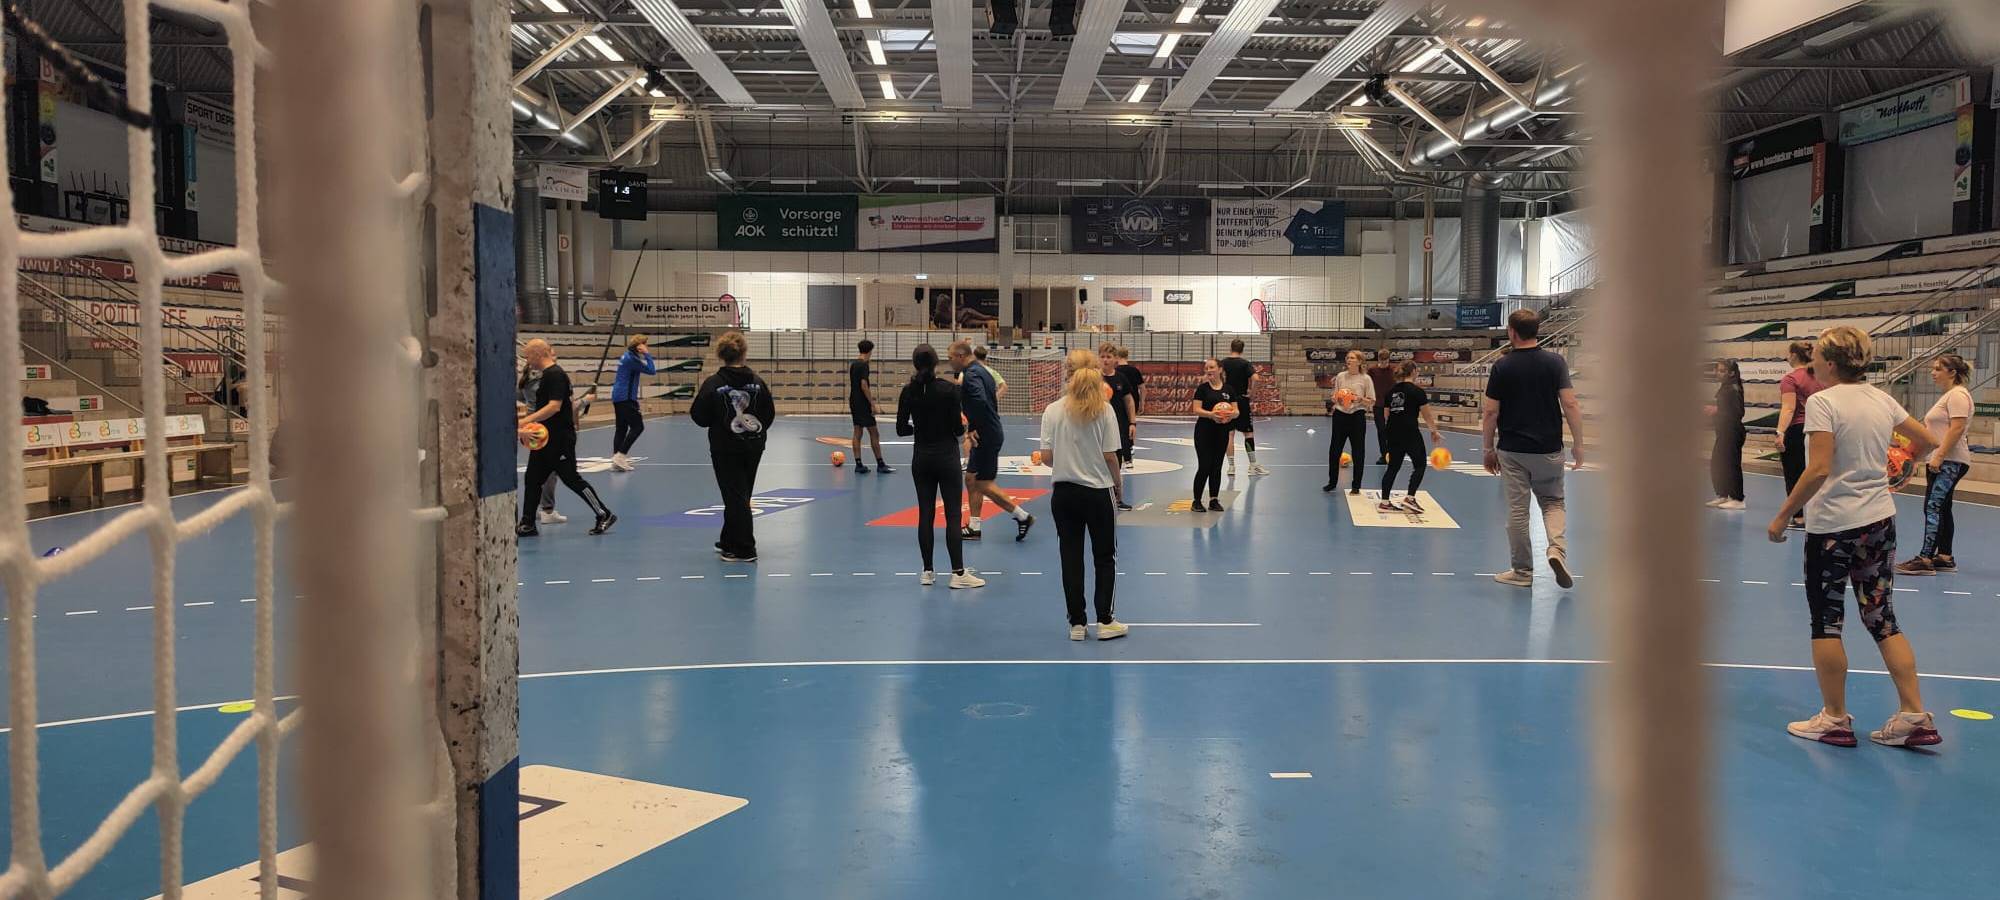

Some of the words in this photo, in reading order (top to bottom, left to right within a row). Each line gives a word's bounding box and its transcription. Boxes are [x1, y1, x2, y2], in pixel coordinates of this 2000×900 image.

[187, 103, 215, 121] SPORT
[779, 207, 842, 222] Vorsorge
[1216, 208, 1231, 216] NUR
[1233, 208, 1253, 216] EINEN
[1120, 217, 1158, 231] WDI
[1216, 218, 1253, 226] ENTFERNT
[1255, 219, 1270, 227] VON
[735, 225, 766, 237] AOK
[781, 223, 839, 237] schützt!
[560, 236, 569, 249] D
[1423, 237, 1432, 250] G
[632, 303, 653, 312] Wir
[656, 303, 698, 312] suchen
[701, 303, 730, 312] Dich!
